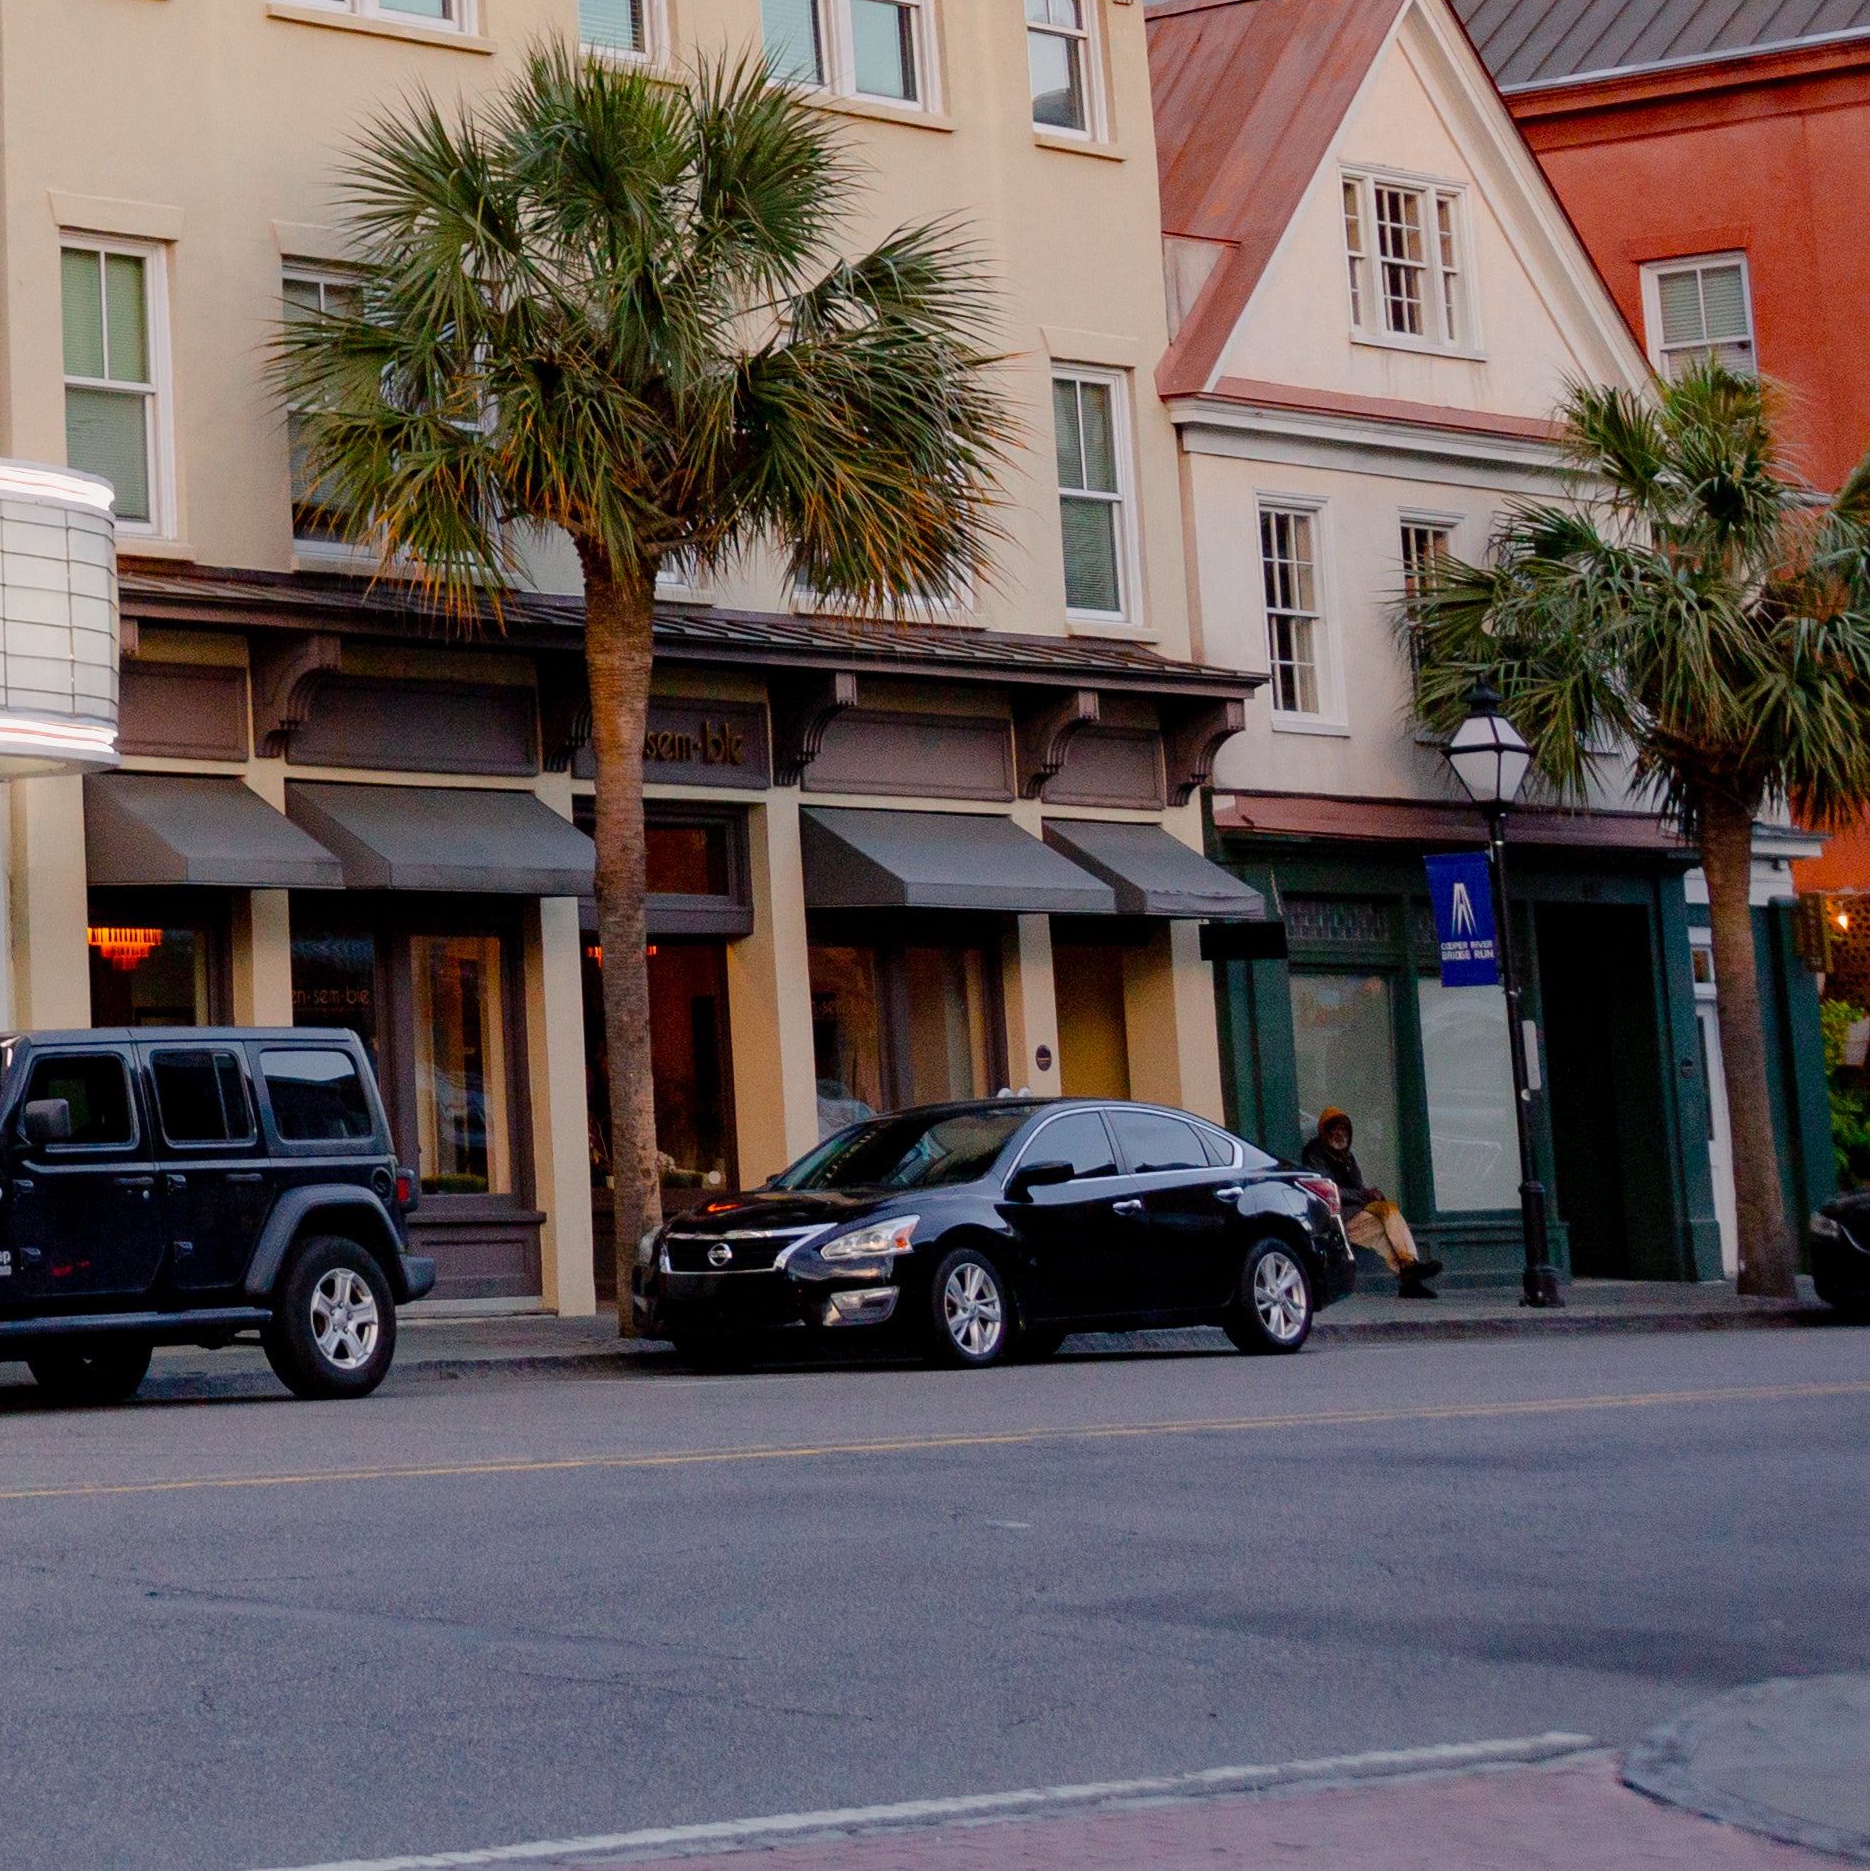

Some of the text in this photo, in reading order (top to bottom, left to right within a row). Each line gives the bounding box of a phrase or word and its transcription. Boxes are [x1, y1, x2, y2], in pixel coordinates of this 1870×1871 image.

[1441, 940, 1493, 950] COOPER RIVER
[1442, 949, 1494, 961] BRIDGE RUN
